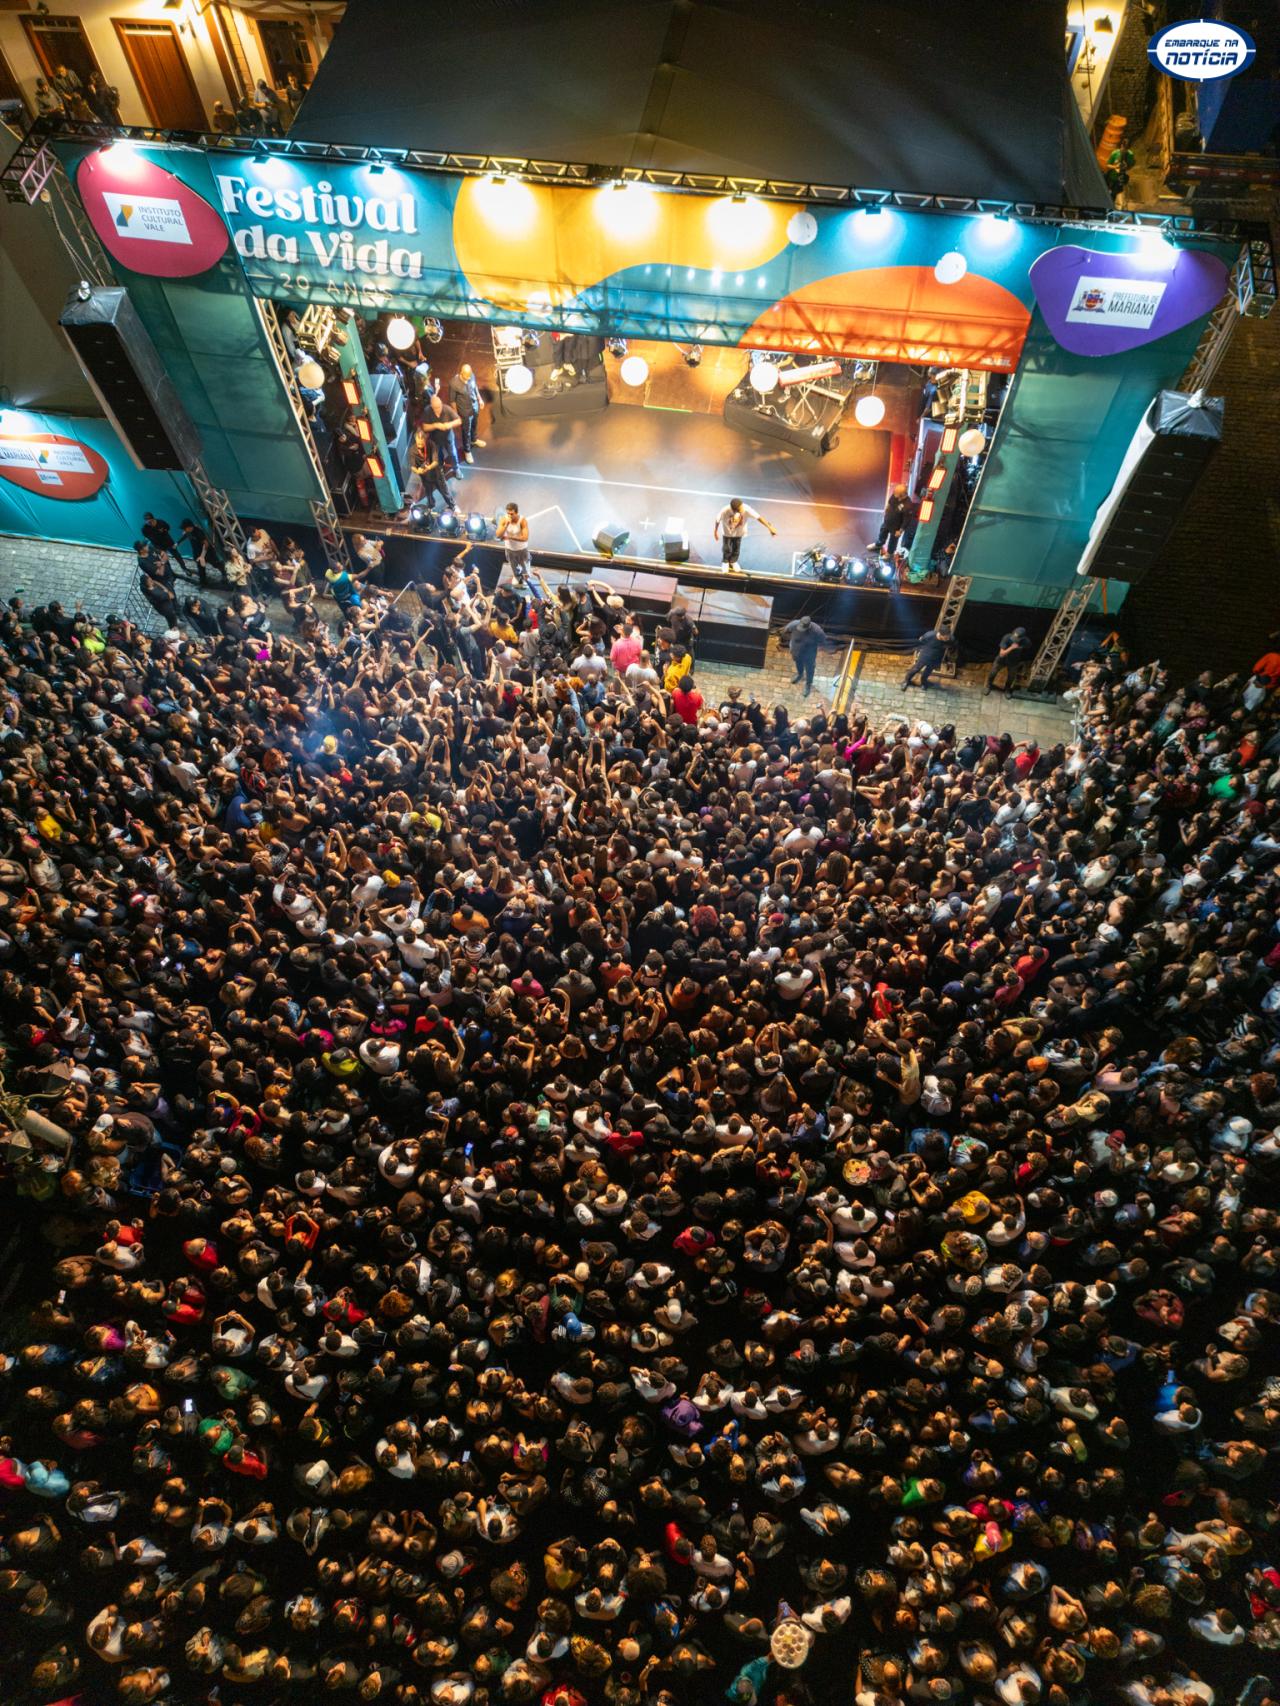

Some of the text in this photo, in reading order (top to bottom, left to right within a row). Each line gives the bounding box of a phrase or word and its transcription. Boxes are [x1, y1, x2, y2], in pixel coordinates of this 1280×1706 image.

[216, 174, 418, 234] Festival
[138, 206, 182, 217] INSTITUTO
[141, 214, 184, 226] CULTURAL
[143, 222, 166, 232] VALE
[234, 224, 424, 280] da Vida
[279, 272, 310, 290] 20
[1108, 301, 1154, 315] MARIANA
